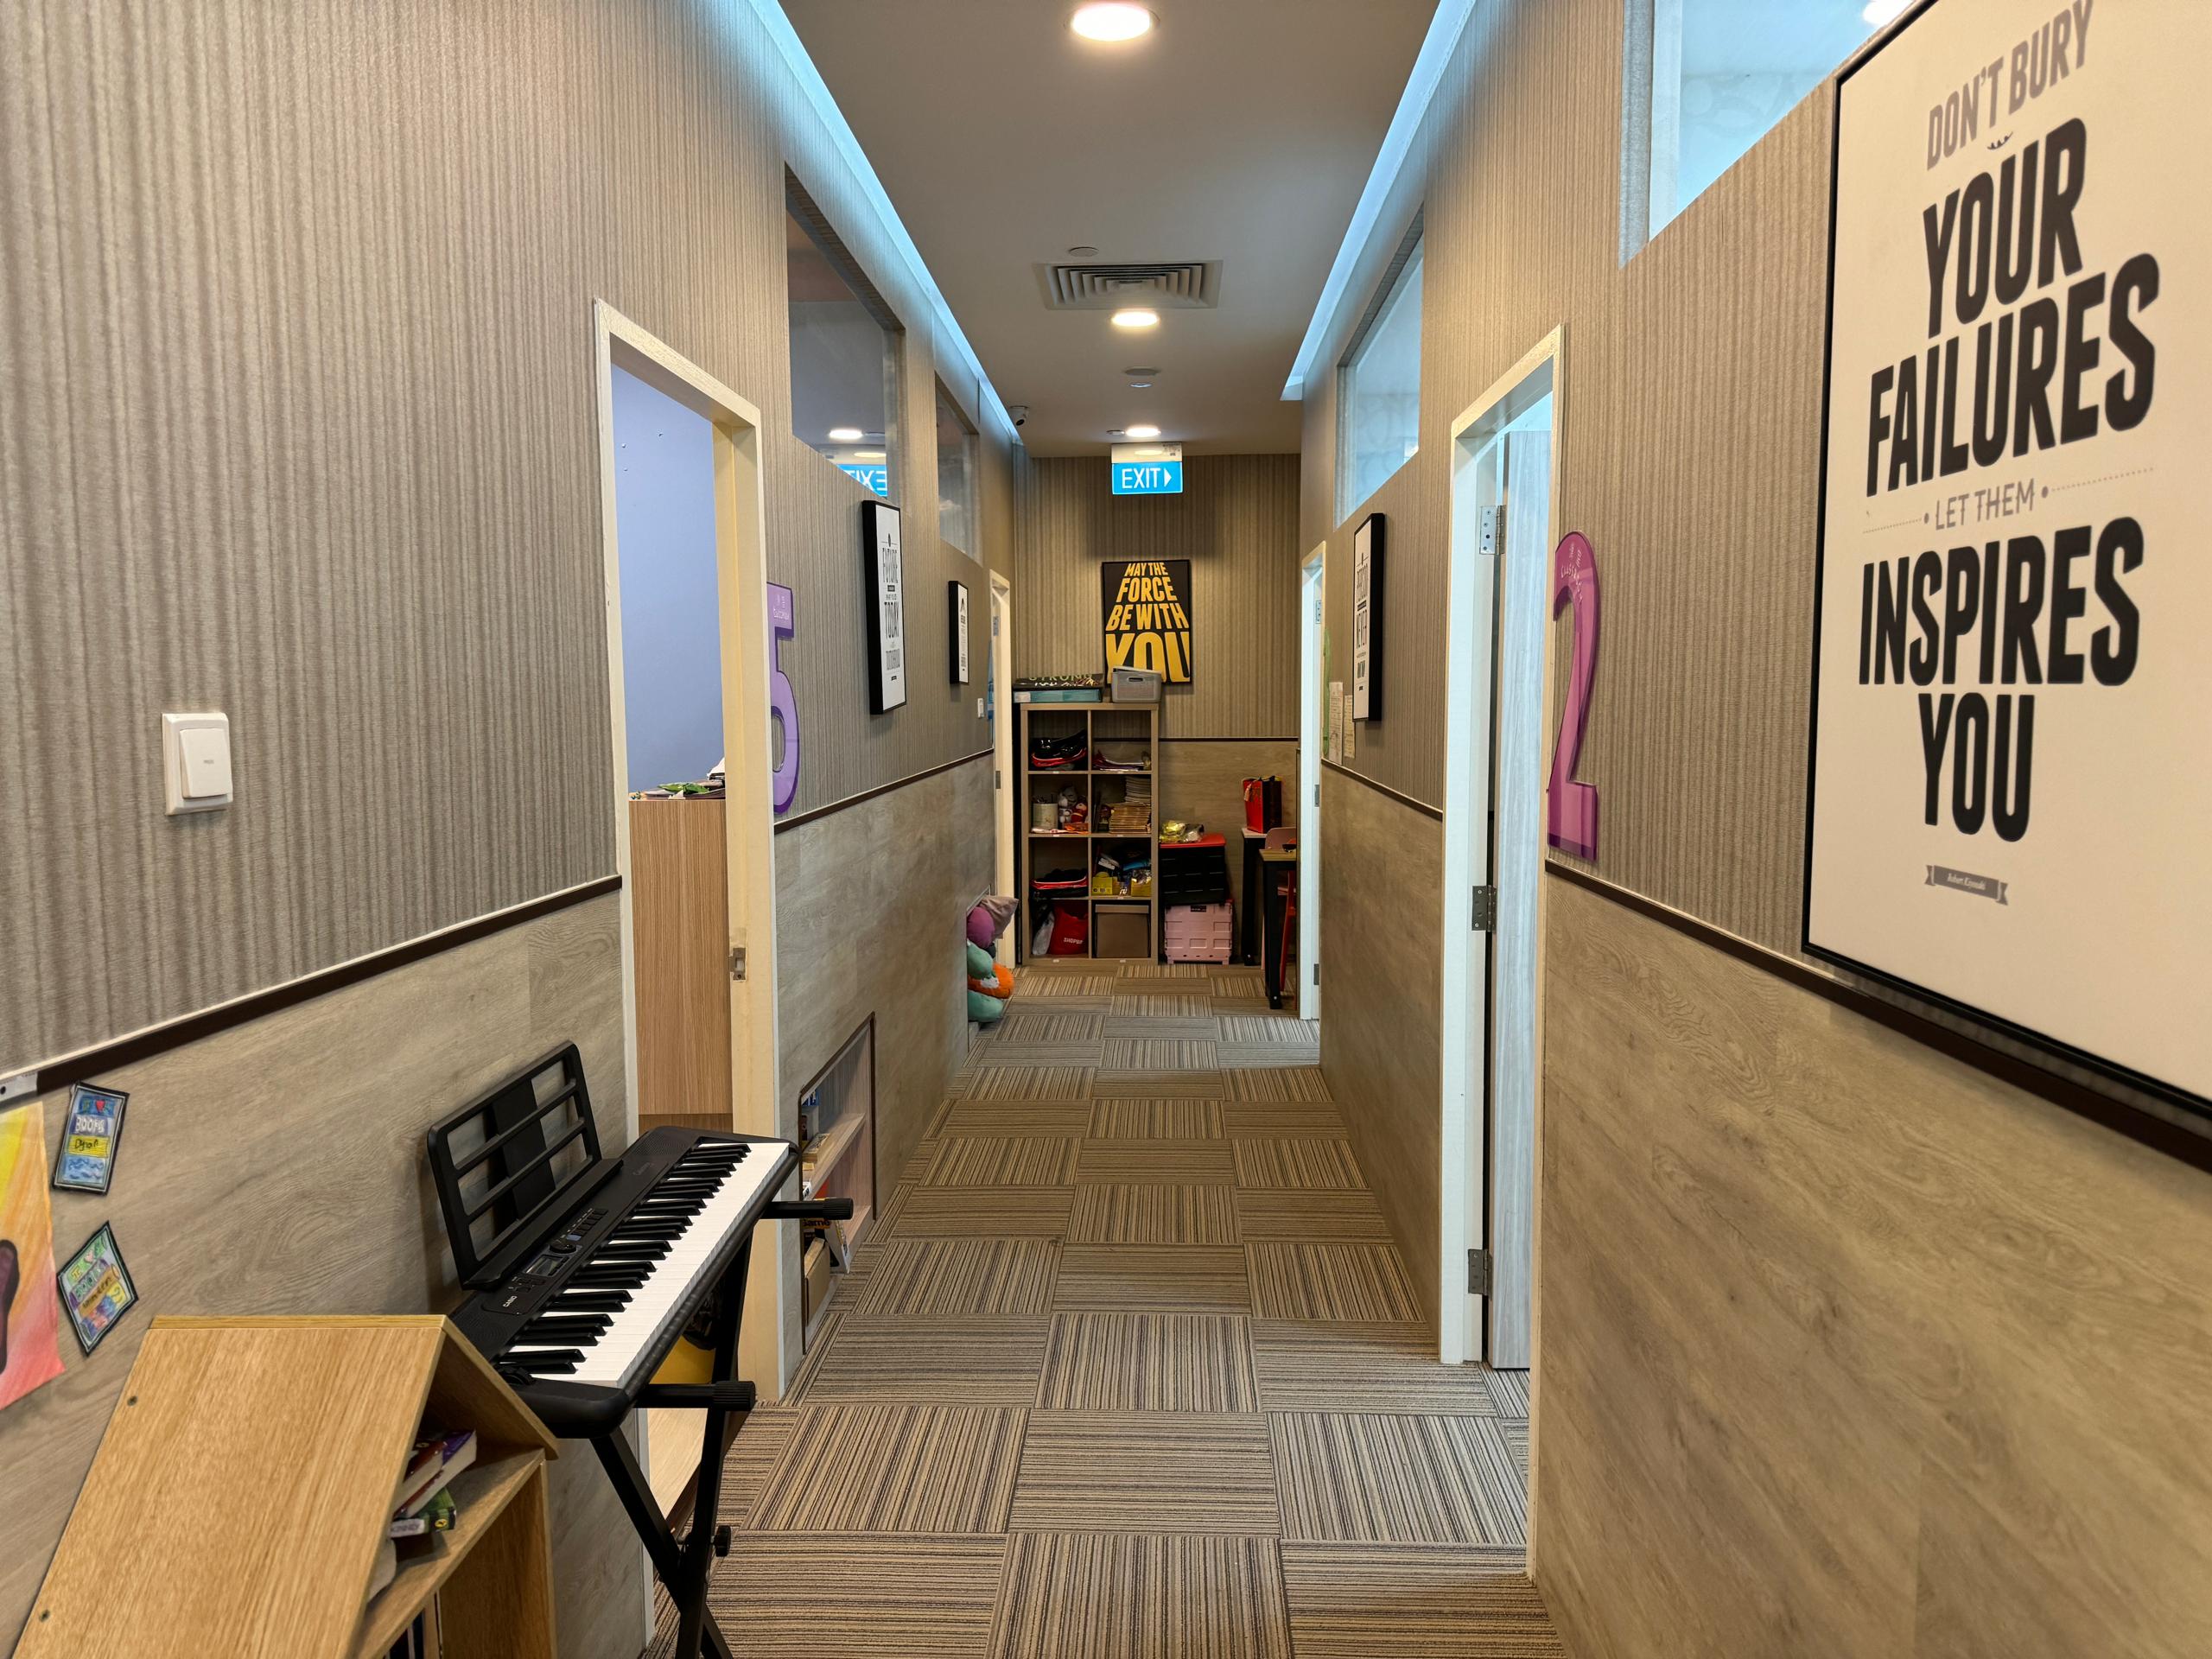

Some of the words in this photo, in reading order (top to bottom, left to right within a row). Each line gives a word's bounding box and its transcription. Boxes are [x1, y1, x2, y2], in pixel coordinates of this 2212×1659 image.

[1927, 56, 2004, 170] DON'T
[2008, 0, 2094, 115] BURY
[1923, 118, 2087, 339] YOUR
[1866, 253, 2159, 497] FAILURES
[1122, 467, 1160, 489] EXIT
[1936, 493, 1969, 531] LET
[1974, 478, 2035, 522] THEM
[1105, 604, 1134, 631] BE
[1135, 602, 1190, 630] WITH
[1116, 576, 1178, 602] FORCE
[1124, 563, 1147, 576] MAY
[1148, 562, 1168, 575] THE
[1859, 517, 2144, 686] INSPIRES
[1105, 631, 1190, 683] YOU
[1547, 531, 1599, 861] 2
[1918, 692, 2035, 842] YOU
